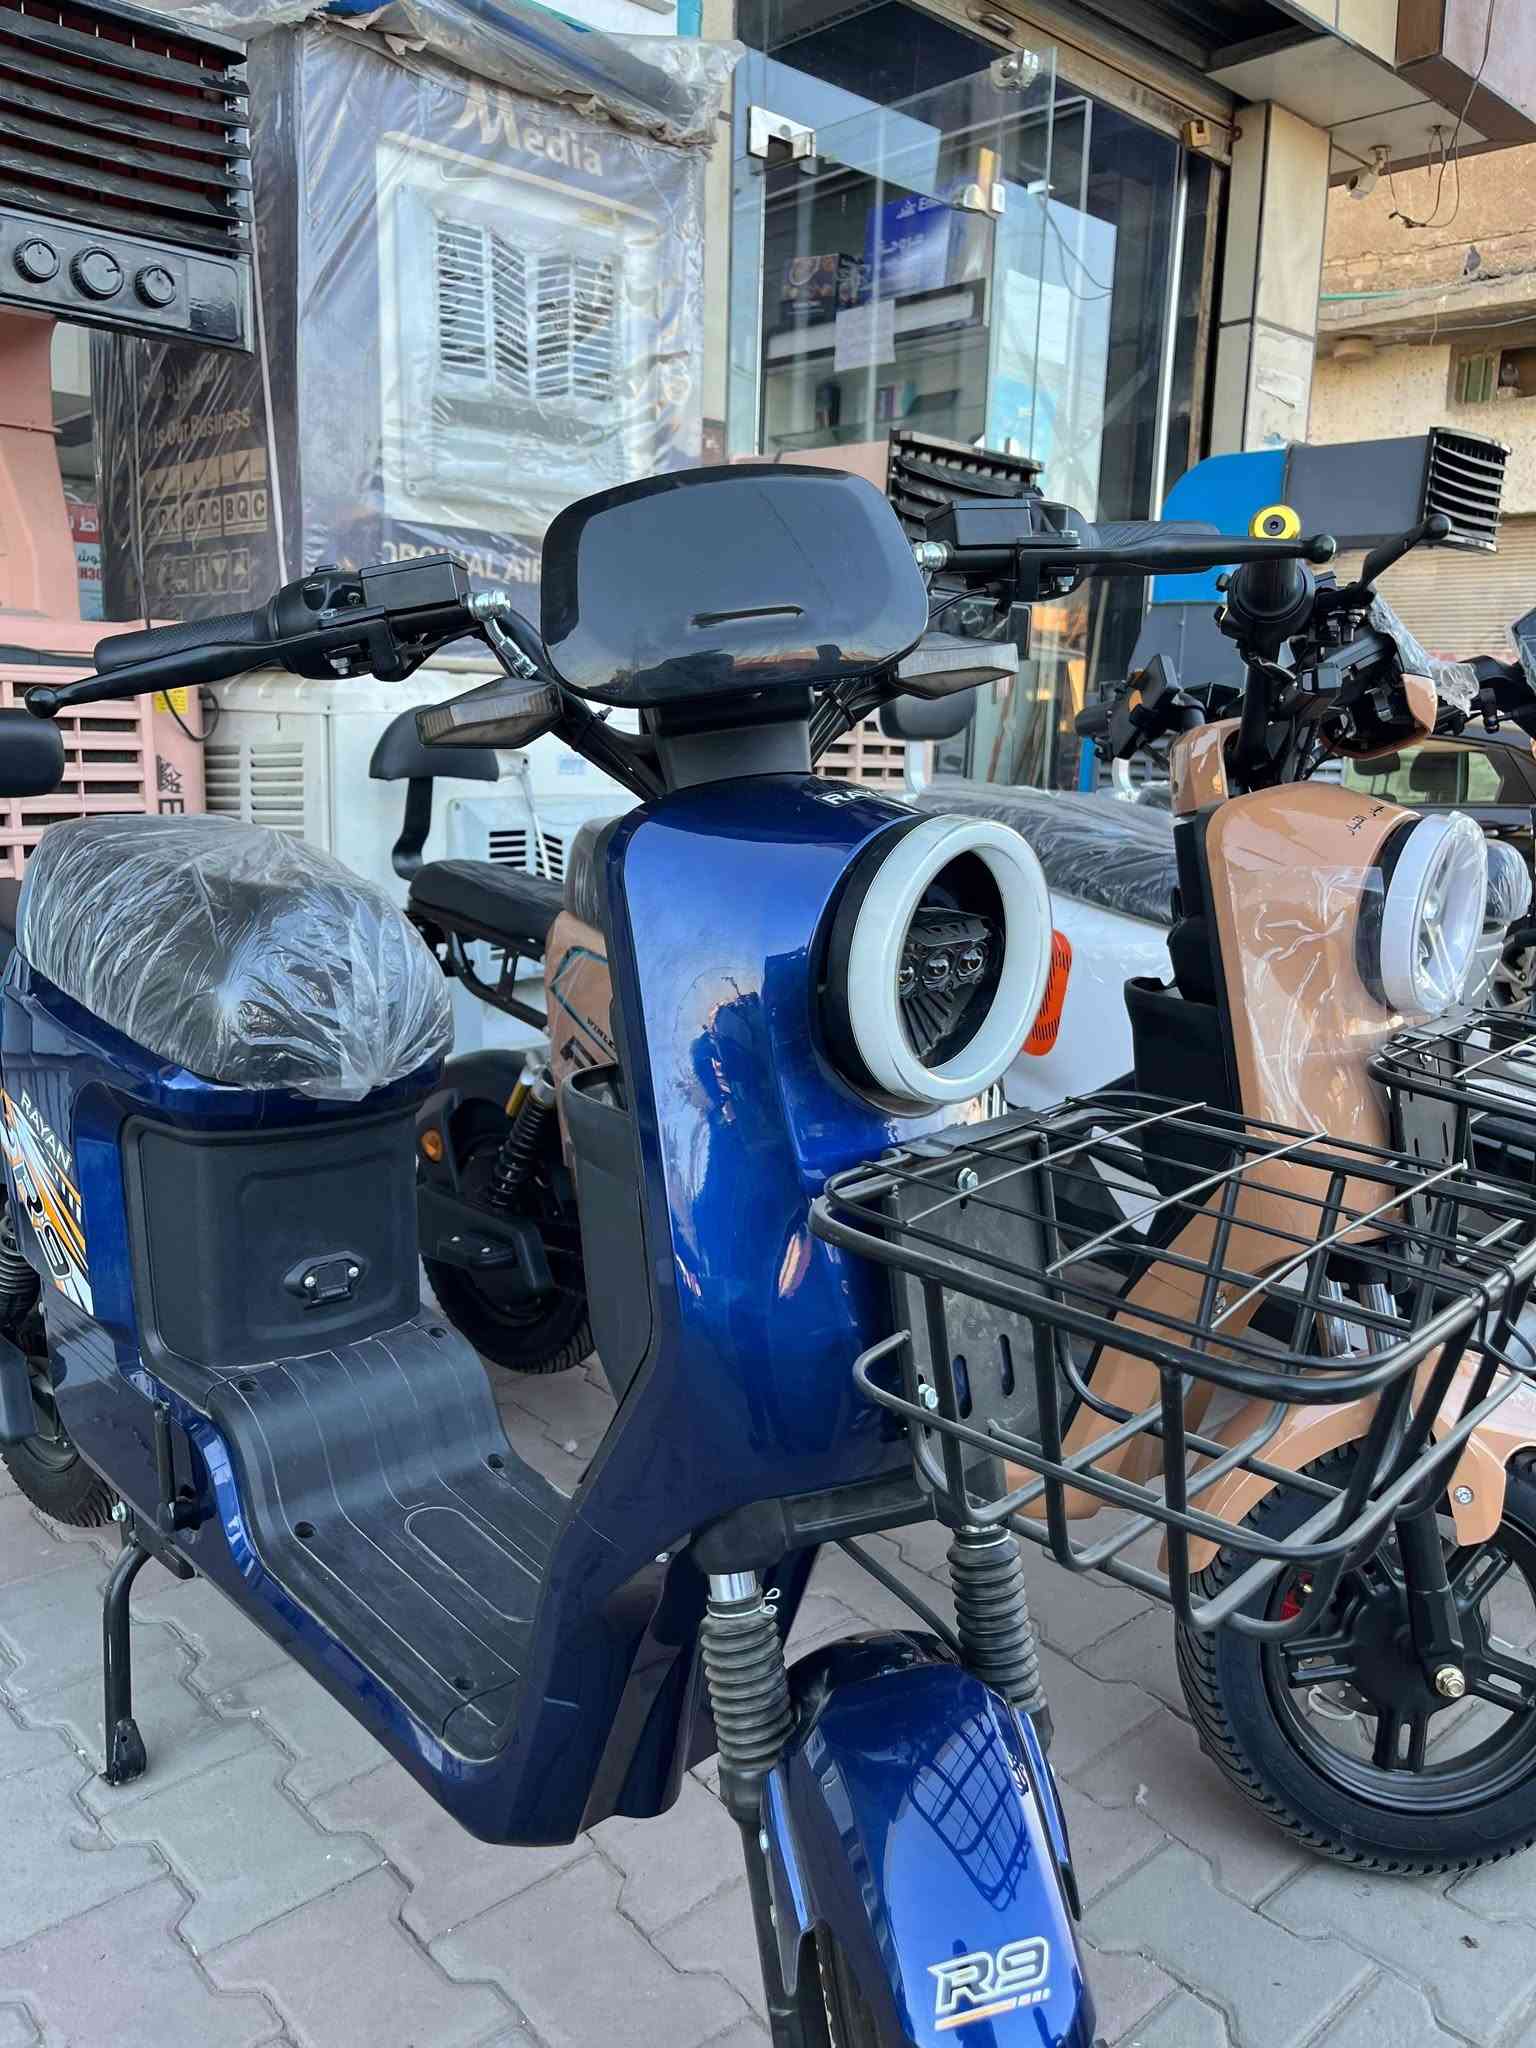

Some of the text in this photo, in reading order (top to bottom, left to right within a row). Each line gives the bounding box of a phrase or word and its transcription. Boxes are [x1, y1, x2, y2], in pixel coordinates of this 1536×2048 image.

[453, 81, 603, 177] Media
[226, 493, 265, 520] BQC
[21, 1088, 73, 1170] RAYAN
[927, 1935, 1050, 2016] R9
